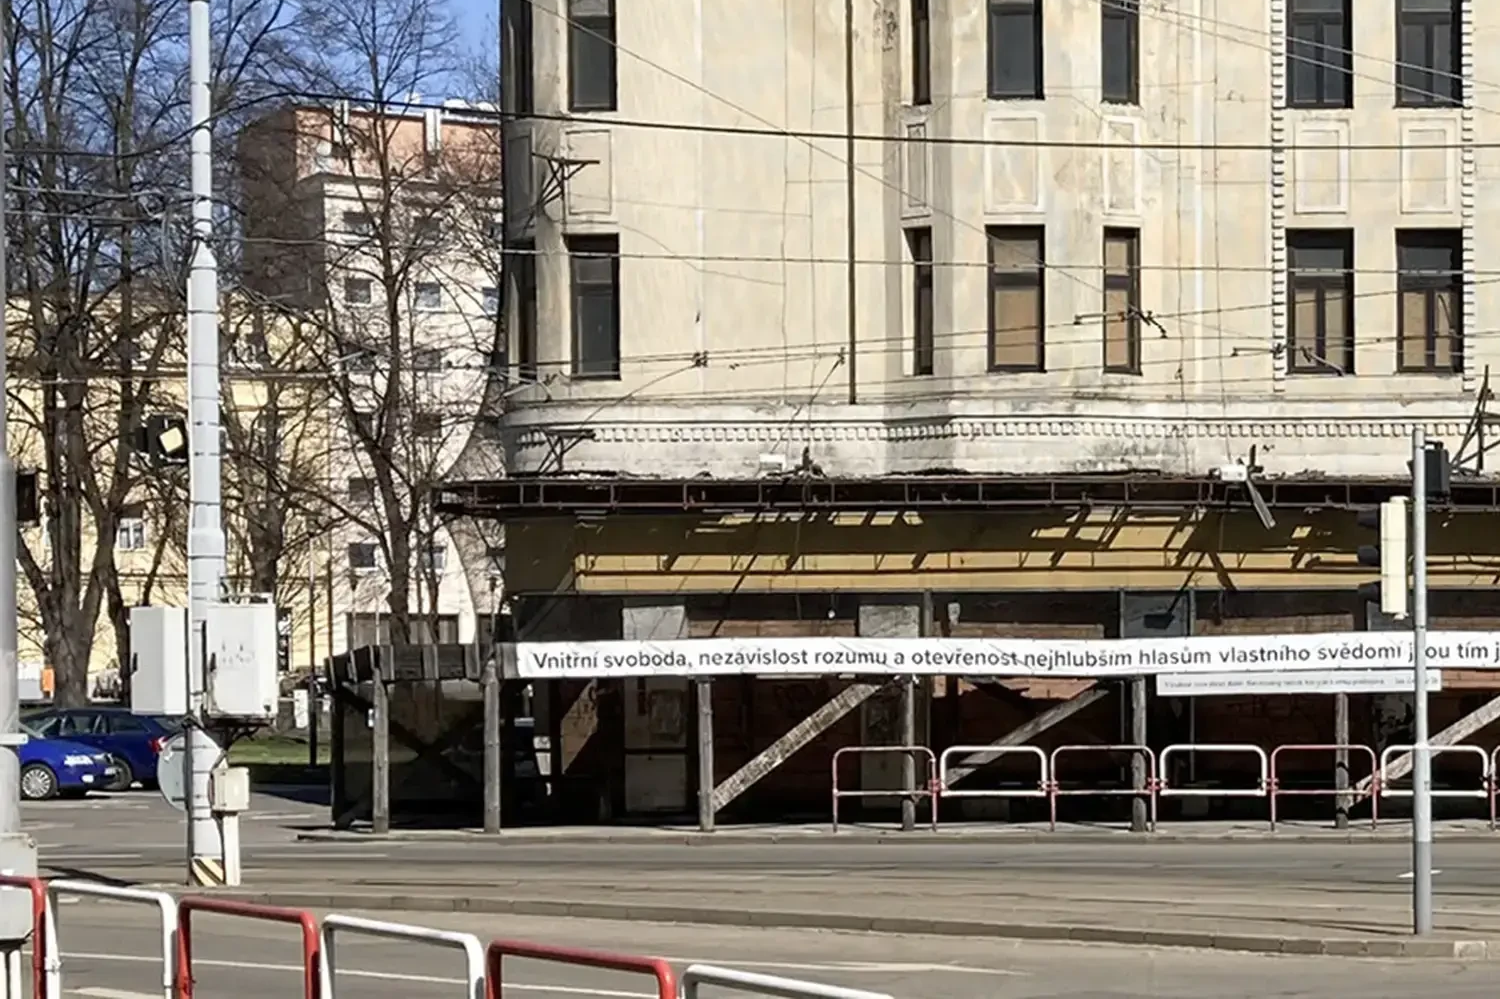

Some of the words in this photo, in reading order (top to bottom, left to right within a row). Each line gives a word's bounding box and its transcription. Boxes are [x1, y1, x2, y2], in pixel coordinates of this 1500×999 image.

[532, 651, 598, 669] Vnitřní
[603, 650, 693, 669] svoboda,
[814, 650, 888, 666] rozumu
[893, 651, 905, 665] a
[911, 648, 1018, 667] otevřenost
[1138, 646, 1212, 665] hlasům
[1218, 645, 1310, 664] vlastního
[1407, 641, 1450, 663] jou
[1456, 641, 1489, 659] tím
